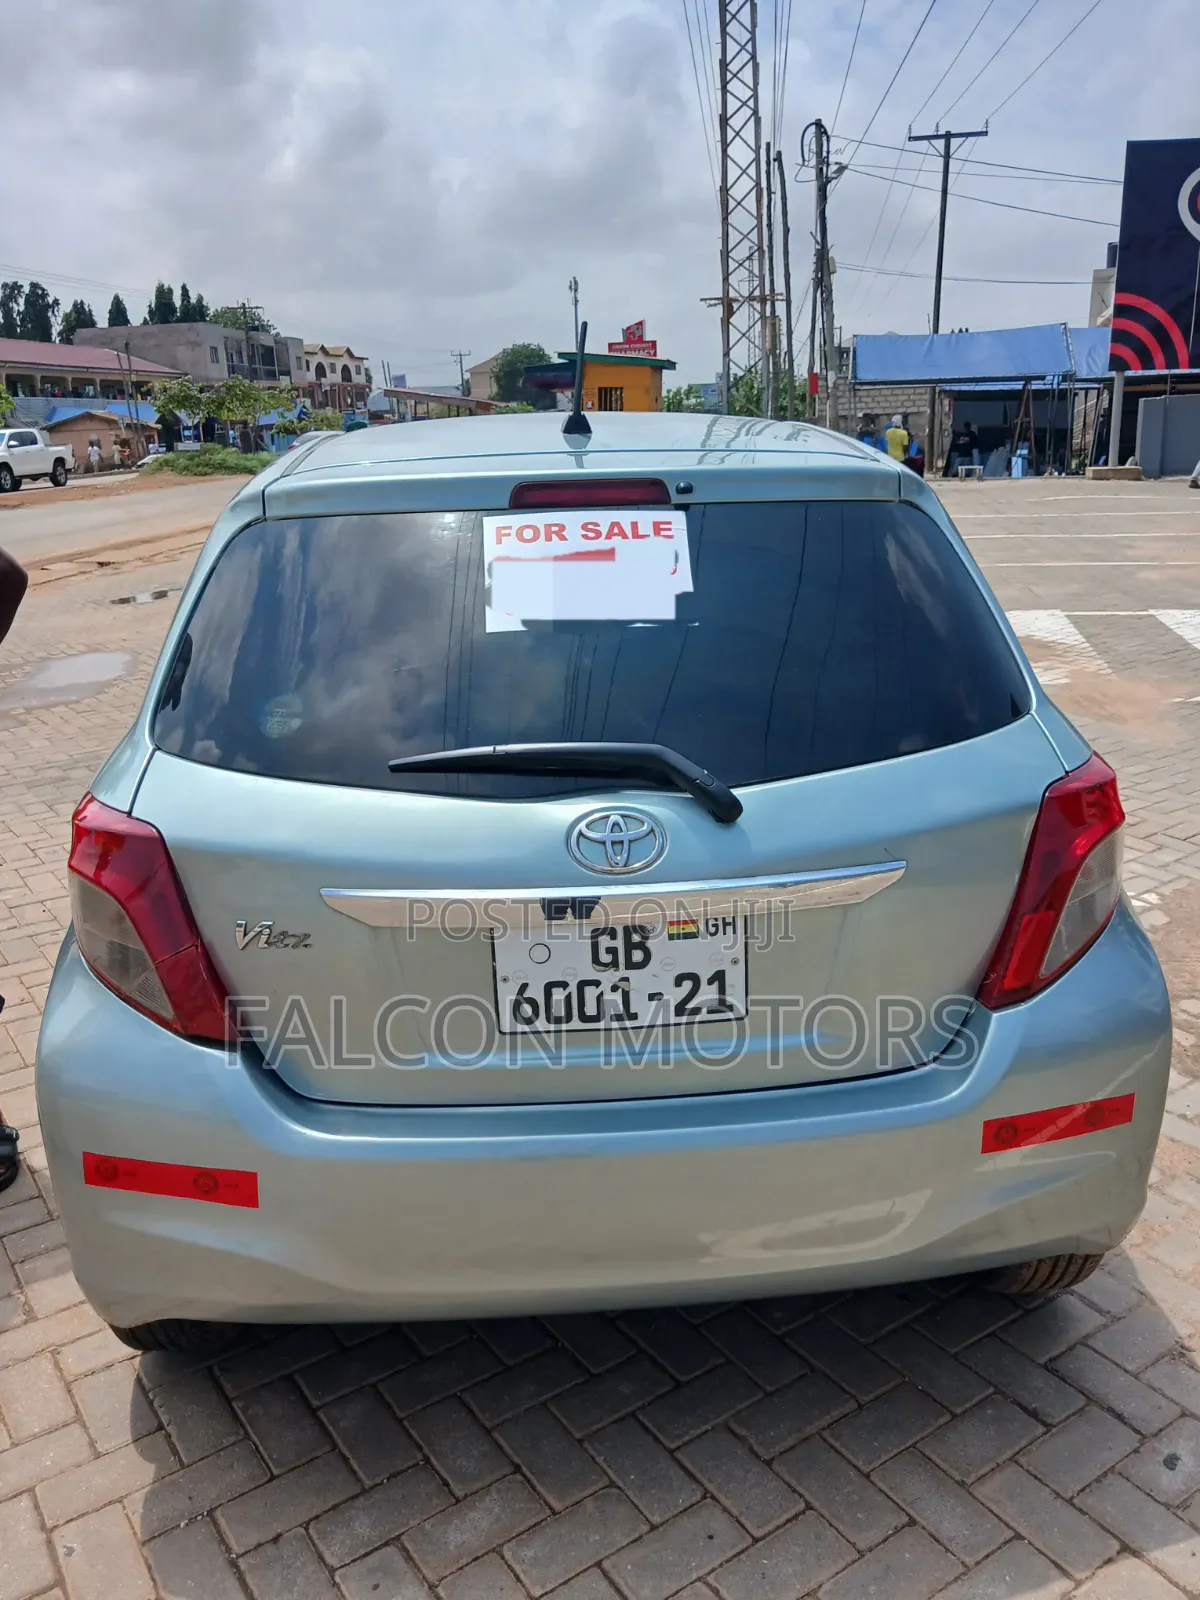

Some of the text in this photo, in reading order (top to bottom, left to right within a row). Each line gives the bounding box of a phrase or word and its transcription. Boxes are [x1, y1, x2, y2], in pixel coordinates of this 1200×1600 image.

[495, 521, 674, 545] FOR SALE
[705, 916, 737, 937] GH
[590, 925, 652, 972] GB
